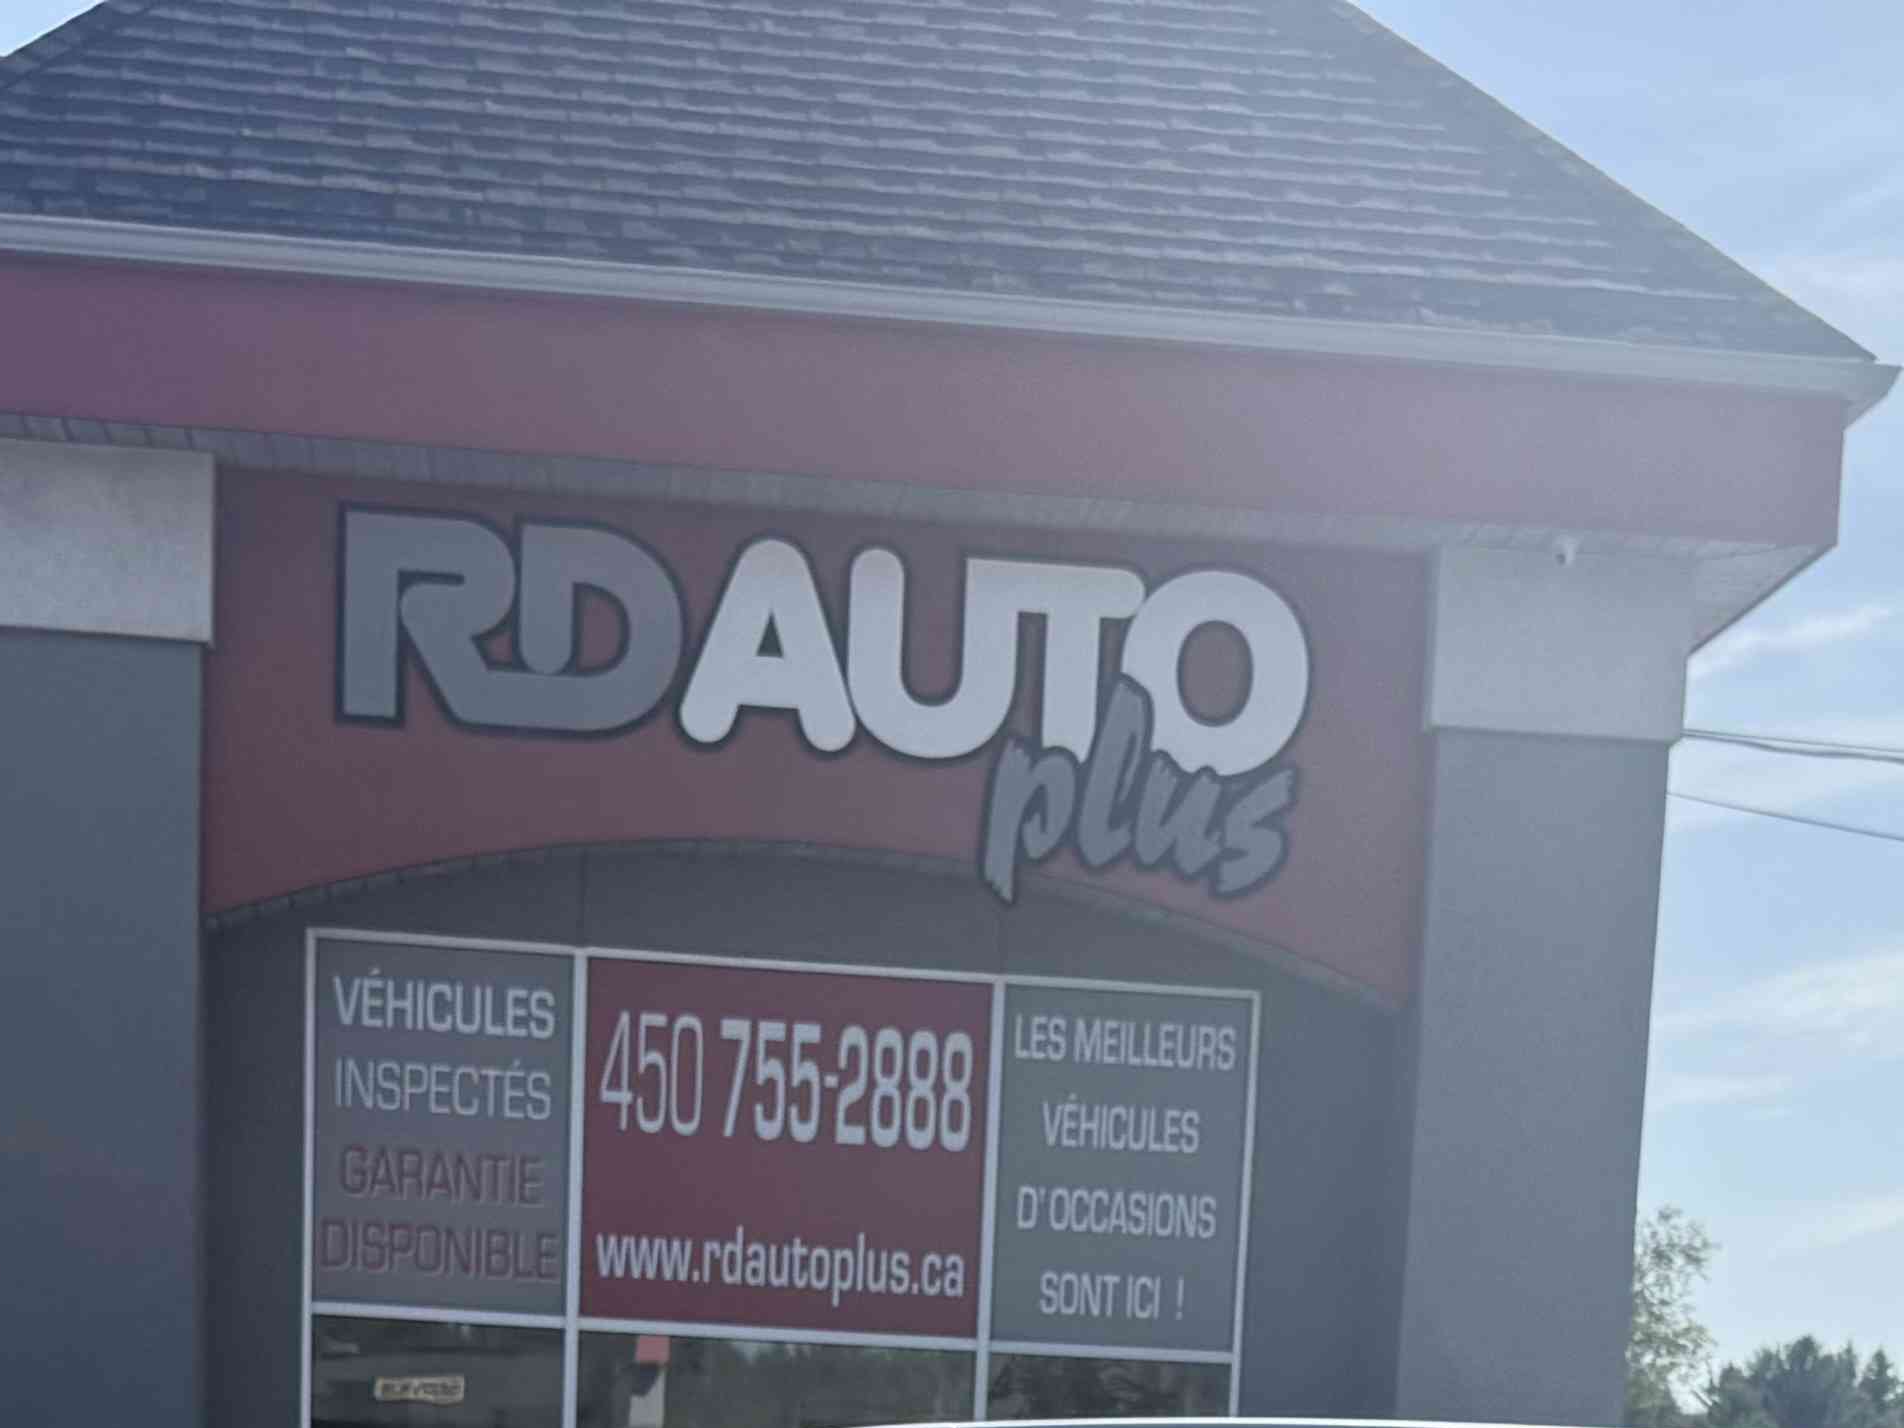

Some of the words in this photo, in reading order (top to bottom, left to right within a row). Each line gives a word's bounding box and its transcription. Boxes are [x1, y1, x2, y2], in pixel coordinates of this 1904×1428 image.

[978, 672, 1295, 903] plus
[332, 967, 557, 1039] VÉHICULES
[1014, 1013, 1067, 1061] LES
[1072, 1016, 1238, 1071] MEILLEURS
[334, 1056, 553, 1121] INSPECTÉS
[599, 1010, 704, 1136] 450
[719, 1017, 974, 1153] 755-2888
[1042, 1092, 1201, 1153] VÉHICULES
[339, 1144, 545, 1208] GARANTIE
[1016, 1185, 1218, 1239] D'OCCASIONS
[318, 1213, 563, 1283] DISPONIBLE
[594, 1223, 966, 1308] www.rdautoplus.ca
[1039, 1270, 1121, 1318] SONT
[1125, 1274, 1162, 1320] ICI
